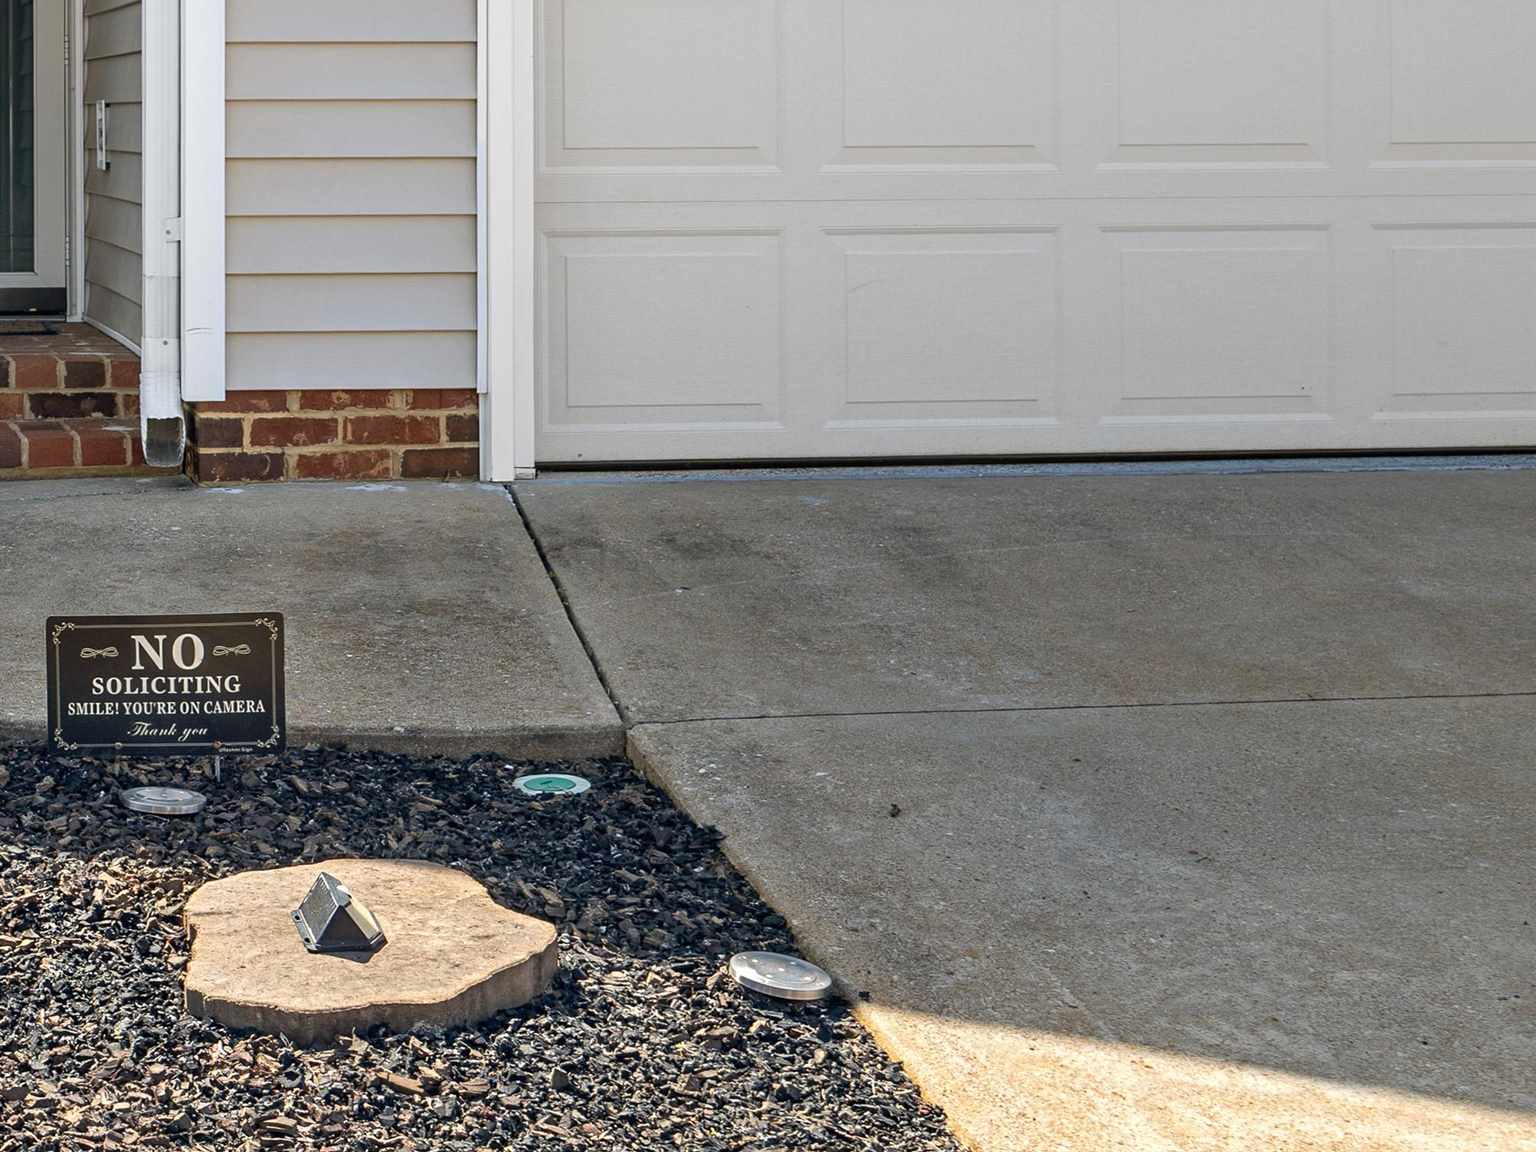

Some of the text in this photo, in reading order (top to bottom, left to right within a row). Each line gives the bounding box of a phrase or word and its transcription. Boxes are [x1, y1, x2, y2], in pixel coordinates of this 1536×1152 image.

[131, 633, 205, 671] NO
[92, 675, 241, 696] SOLICITING
[68, 699, 265, 716] SMILE! YOU'RE ON CAMERA
[127, 721, 208, 741] Thank you
